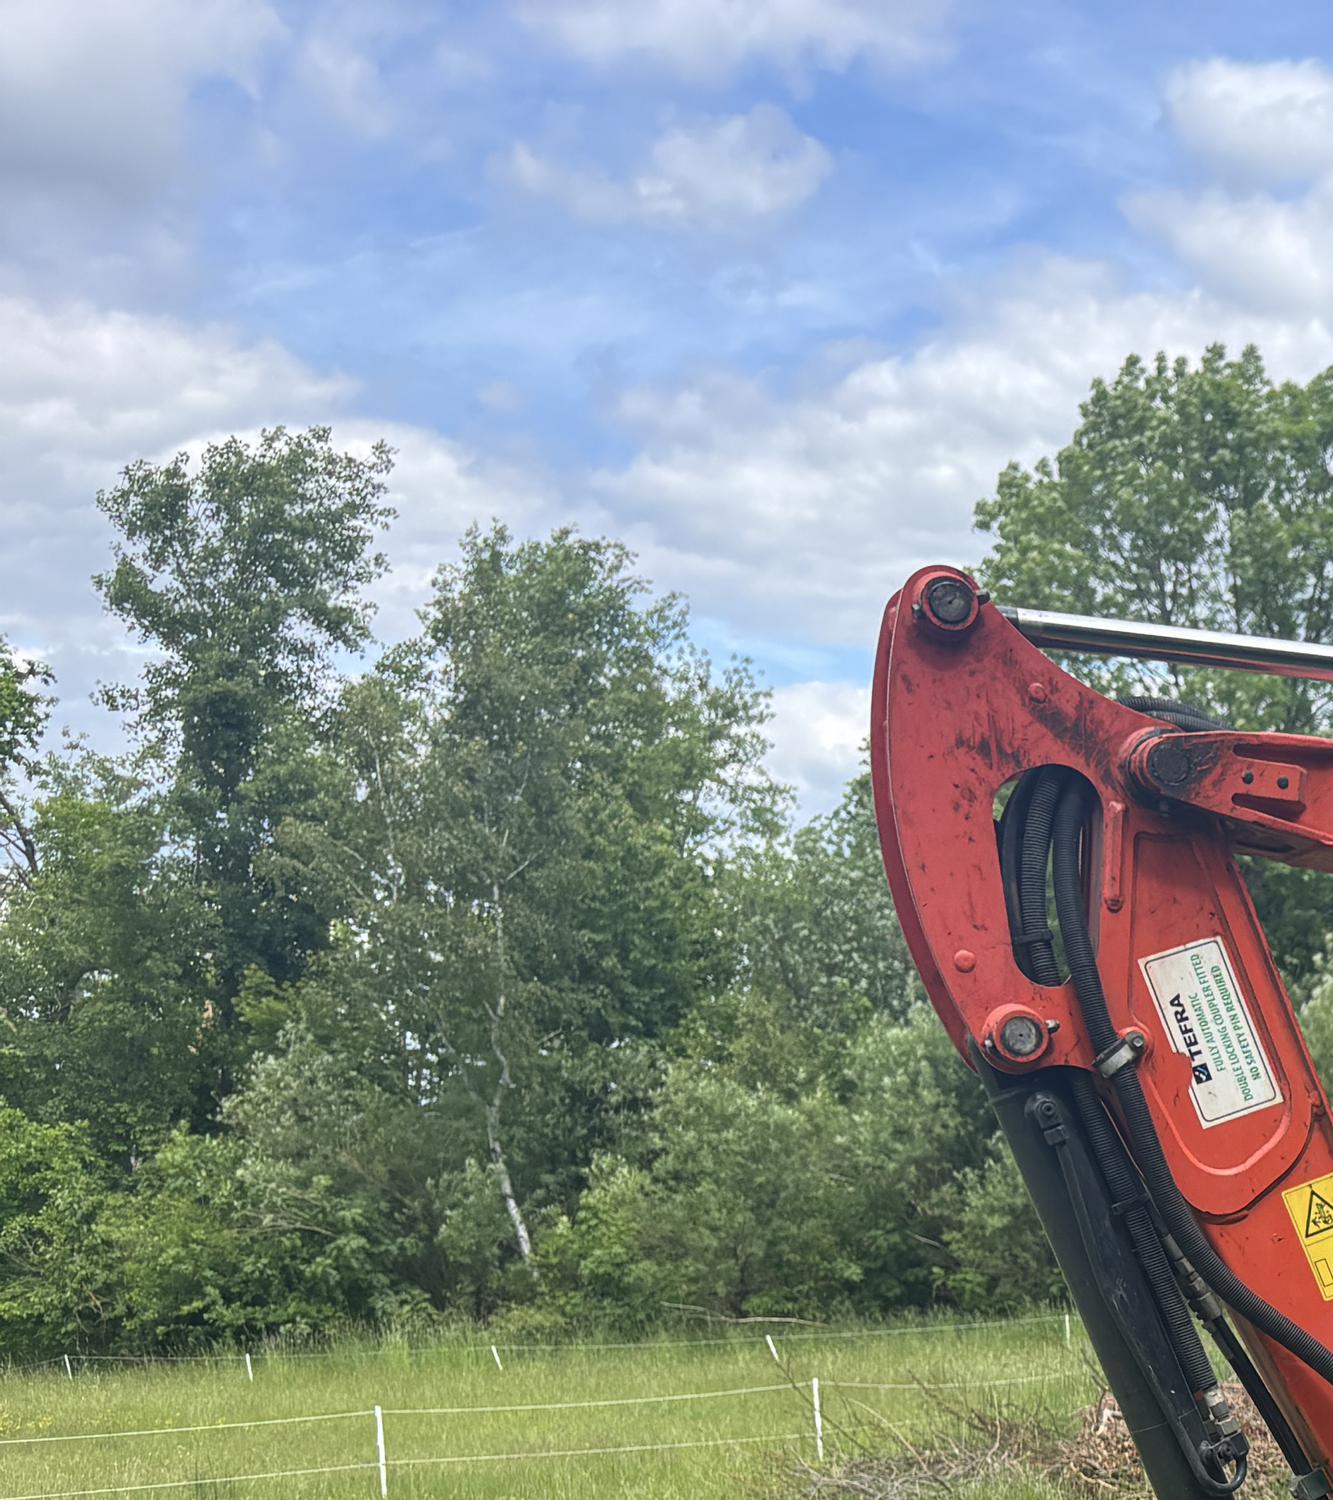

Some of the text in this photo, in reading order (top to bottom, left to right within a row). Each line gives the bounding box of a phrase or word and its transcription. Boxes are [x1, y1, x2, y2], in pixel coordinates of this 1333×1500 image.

[1169, 993, 1202, 1061] TEFRA
[1188, 992, 1225, 1072] FULLY AUTOMATIC
[1190, 954, 1254, 1102] DOUBLE LOCKING COUPLER FITTED
[1211, 965, 1261, 1080] NO SAFETY PIN REQUIRED
